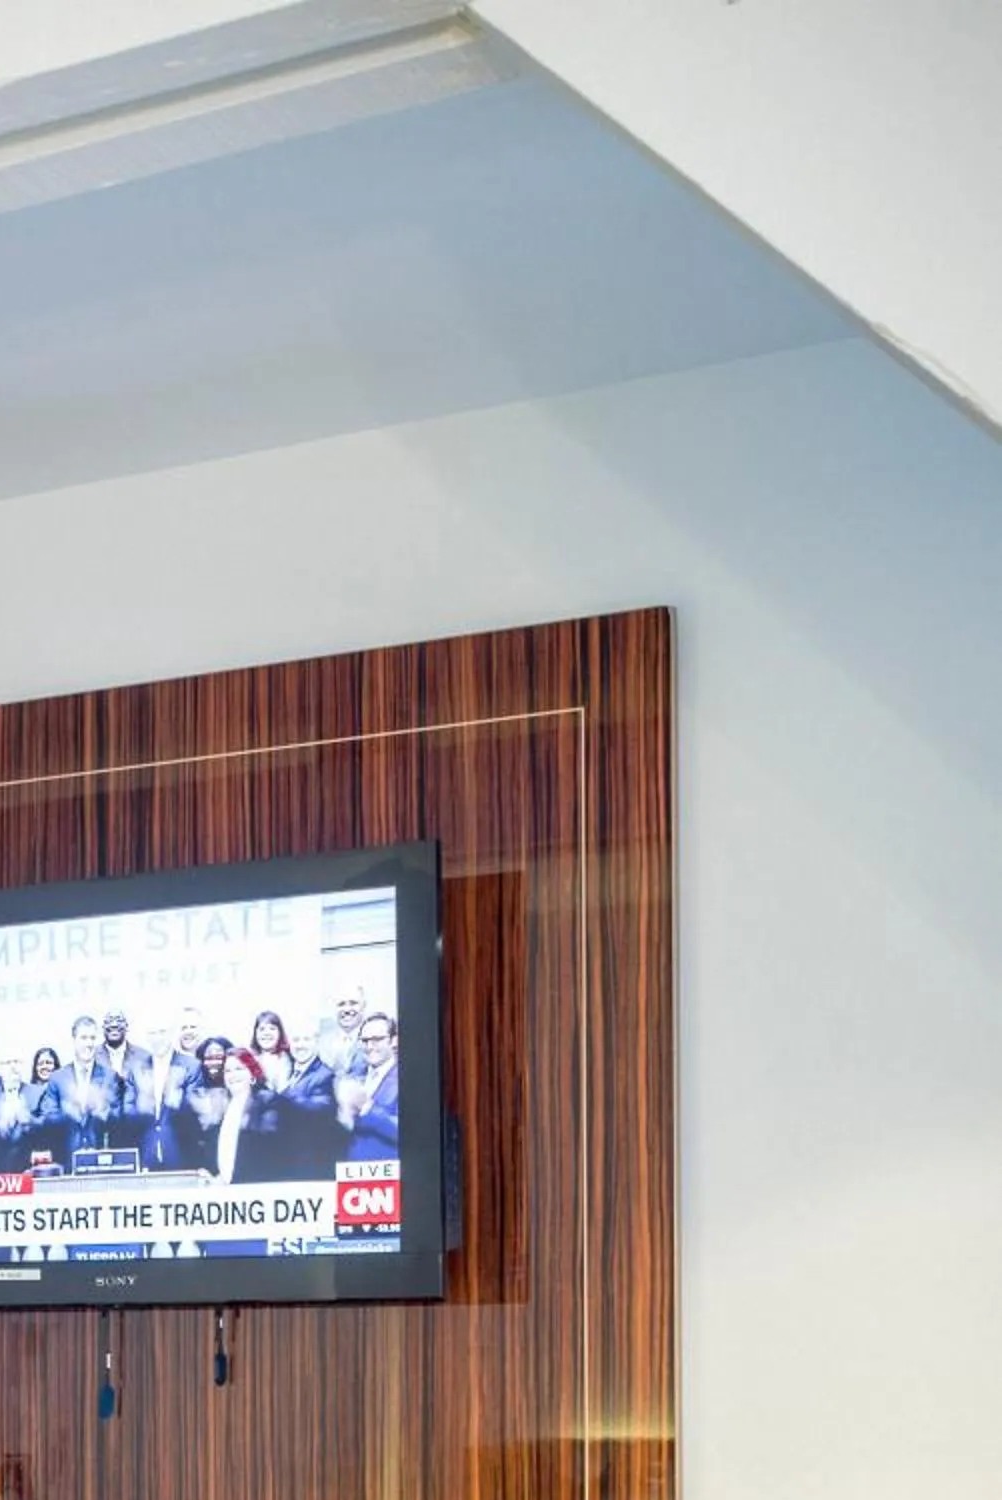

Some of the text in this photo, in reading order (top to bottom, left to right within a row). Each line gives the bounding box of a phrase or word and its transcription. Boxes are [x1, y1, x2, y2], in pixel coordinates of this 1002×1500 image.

[145, 902, 294, 952] STATE
[135, 961, 244, 991] TRUST
[344, 1163, 394, 1179] LIVE
[33, 1206, 103, 1232] START
[109, 1203, 154, 1229] THE
[160, 1200, 265, 1227] TRADING
[274, 1196, 324, 1224] DAY
[342, 1186, 395, 1216] CNN
[94, 1274, 137, 1287] SONY
